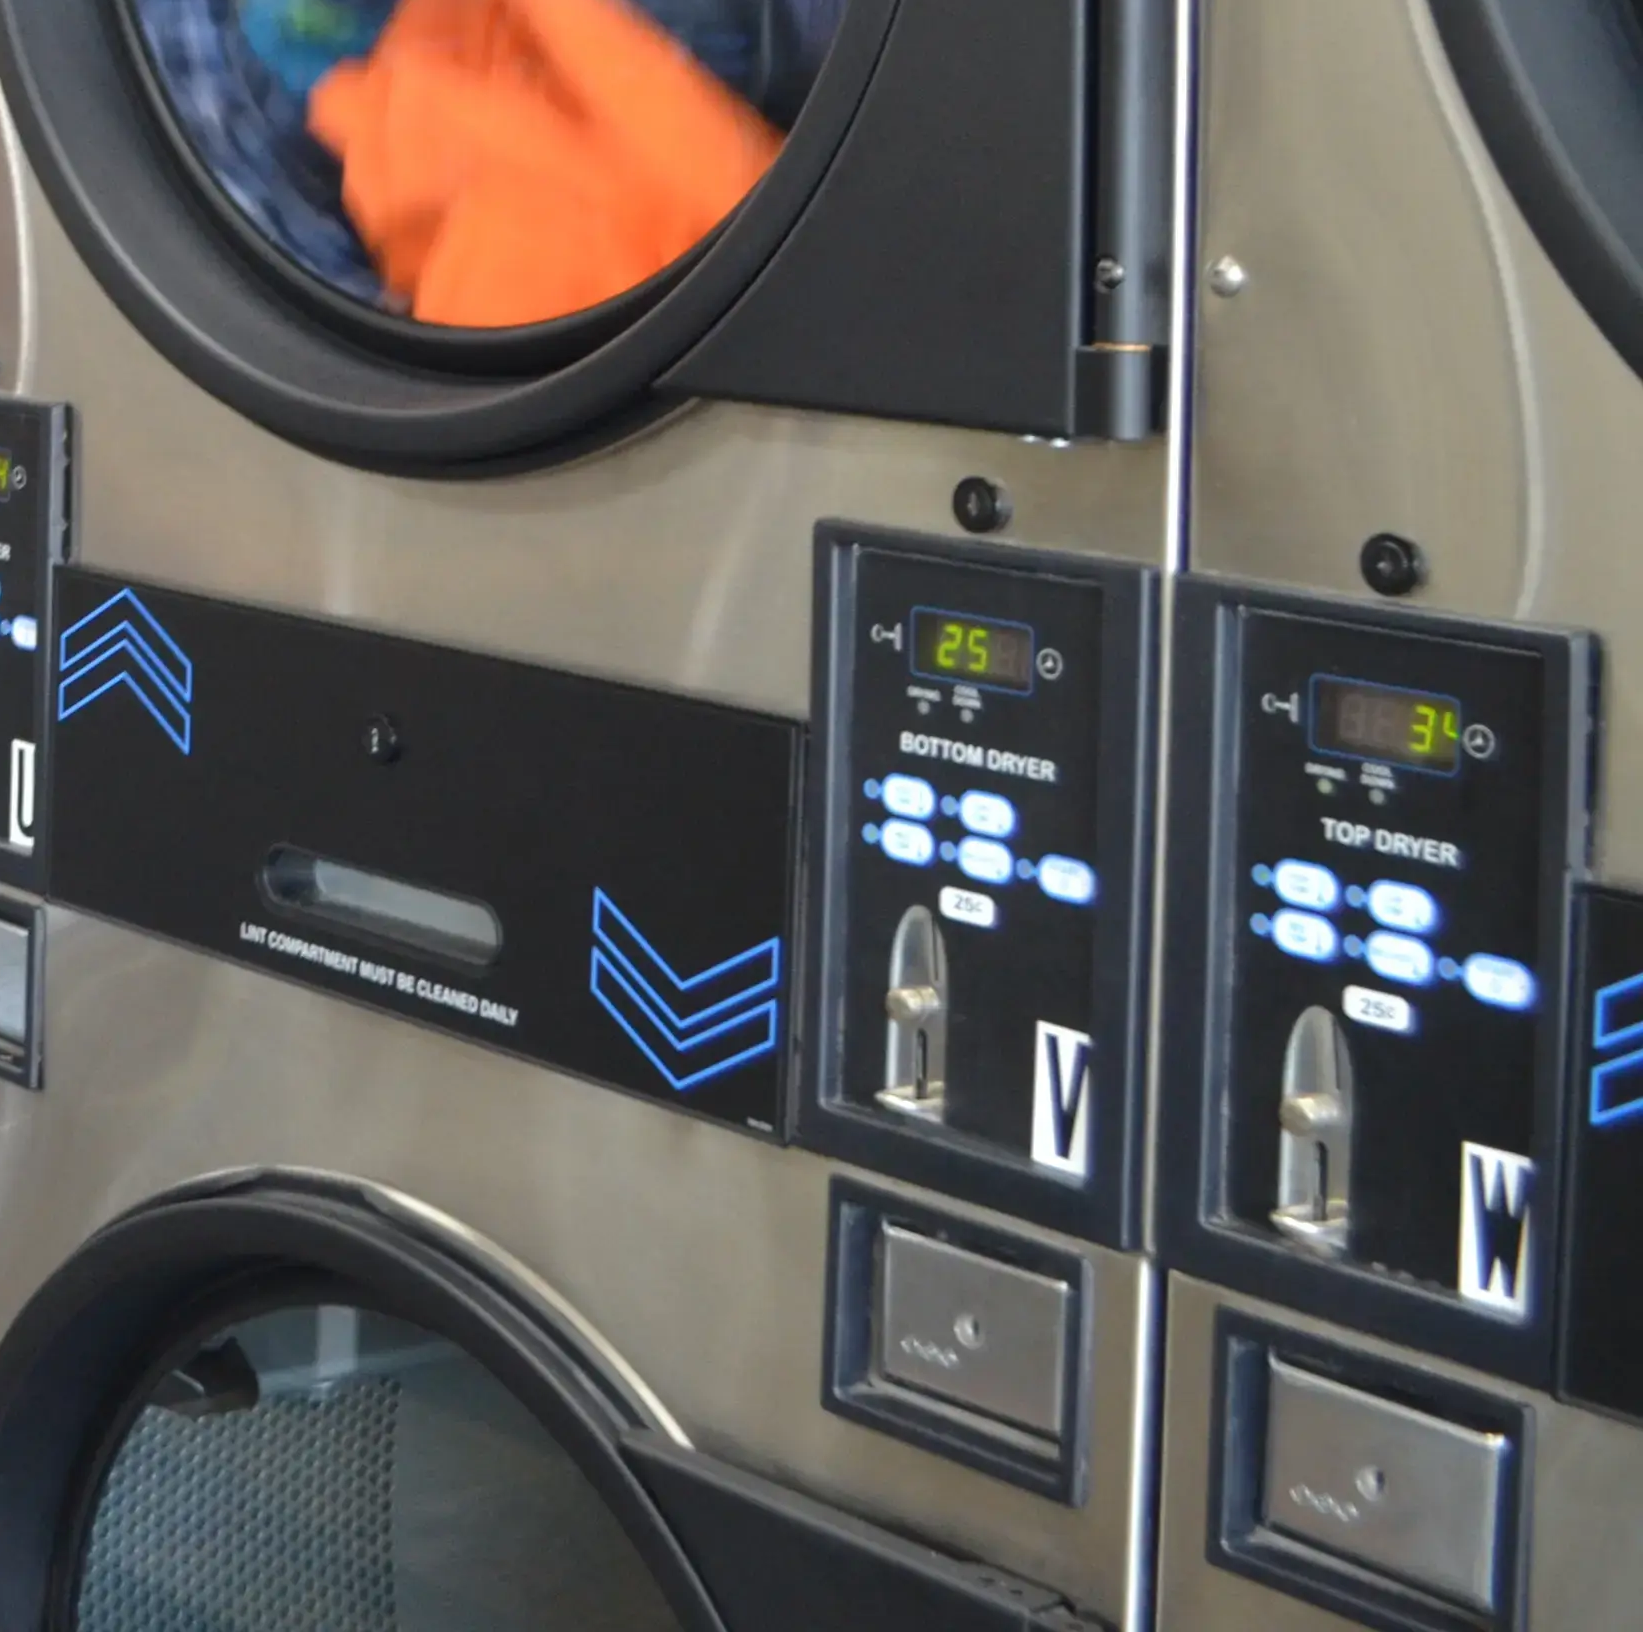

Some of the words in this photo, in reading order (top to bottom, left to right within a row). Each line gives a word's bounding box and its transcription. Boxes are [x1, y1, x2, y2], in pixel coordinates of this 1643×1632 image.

[936, 622, 990, 673] 25
[899, 729, 985, 767] BOTTOM
[985, 748, 1058, 783] DRYER
[1321, 815, 1371, 847] TOP
[1373, 828, 1462, 869] DRYER
[1044, 1031, 1091, 1160] V
[1467, 1151, 1529, 1301] W
